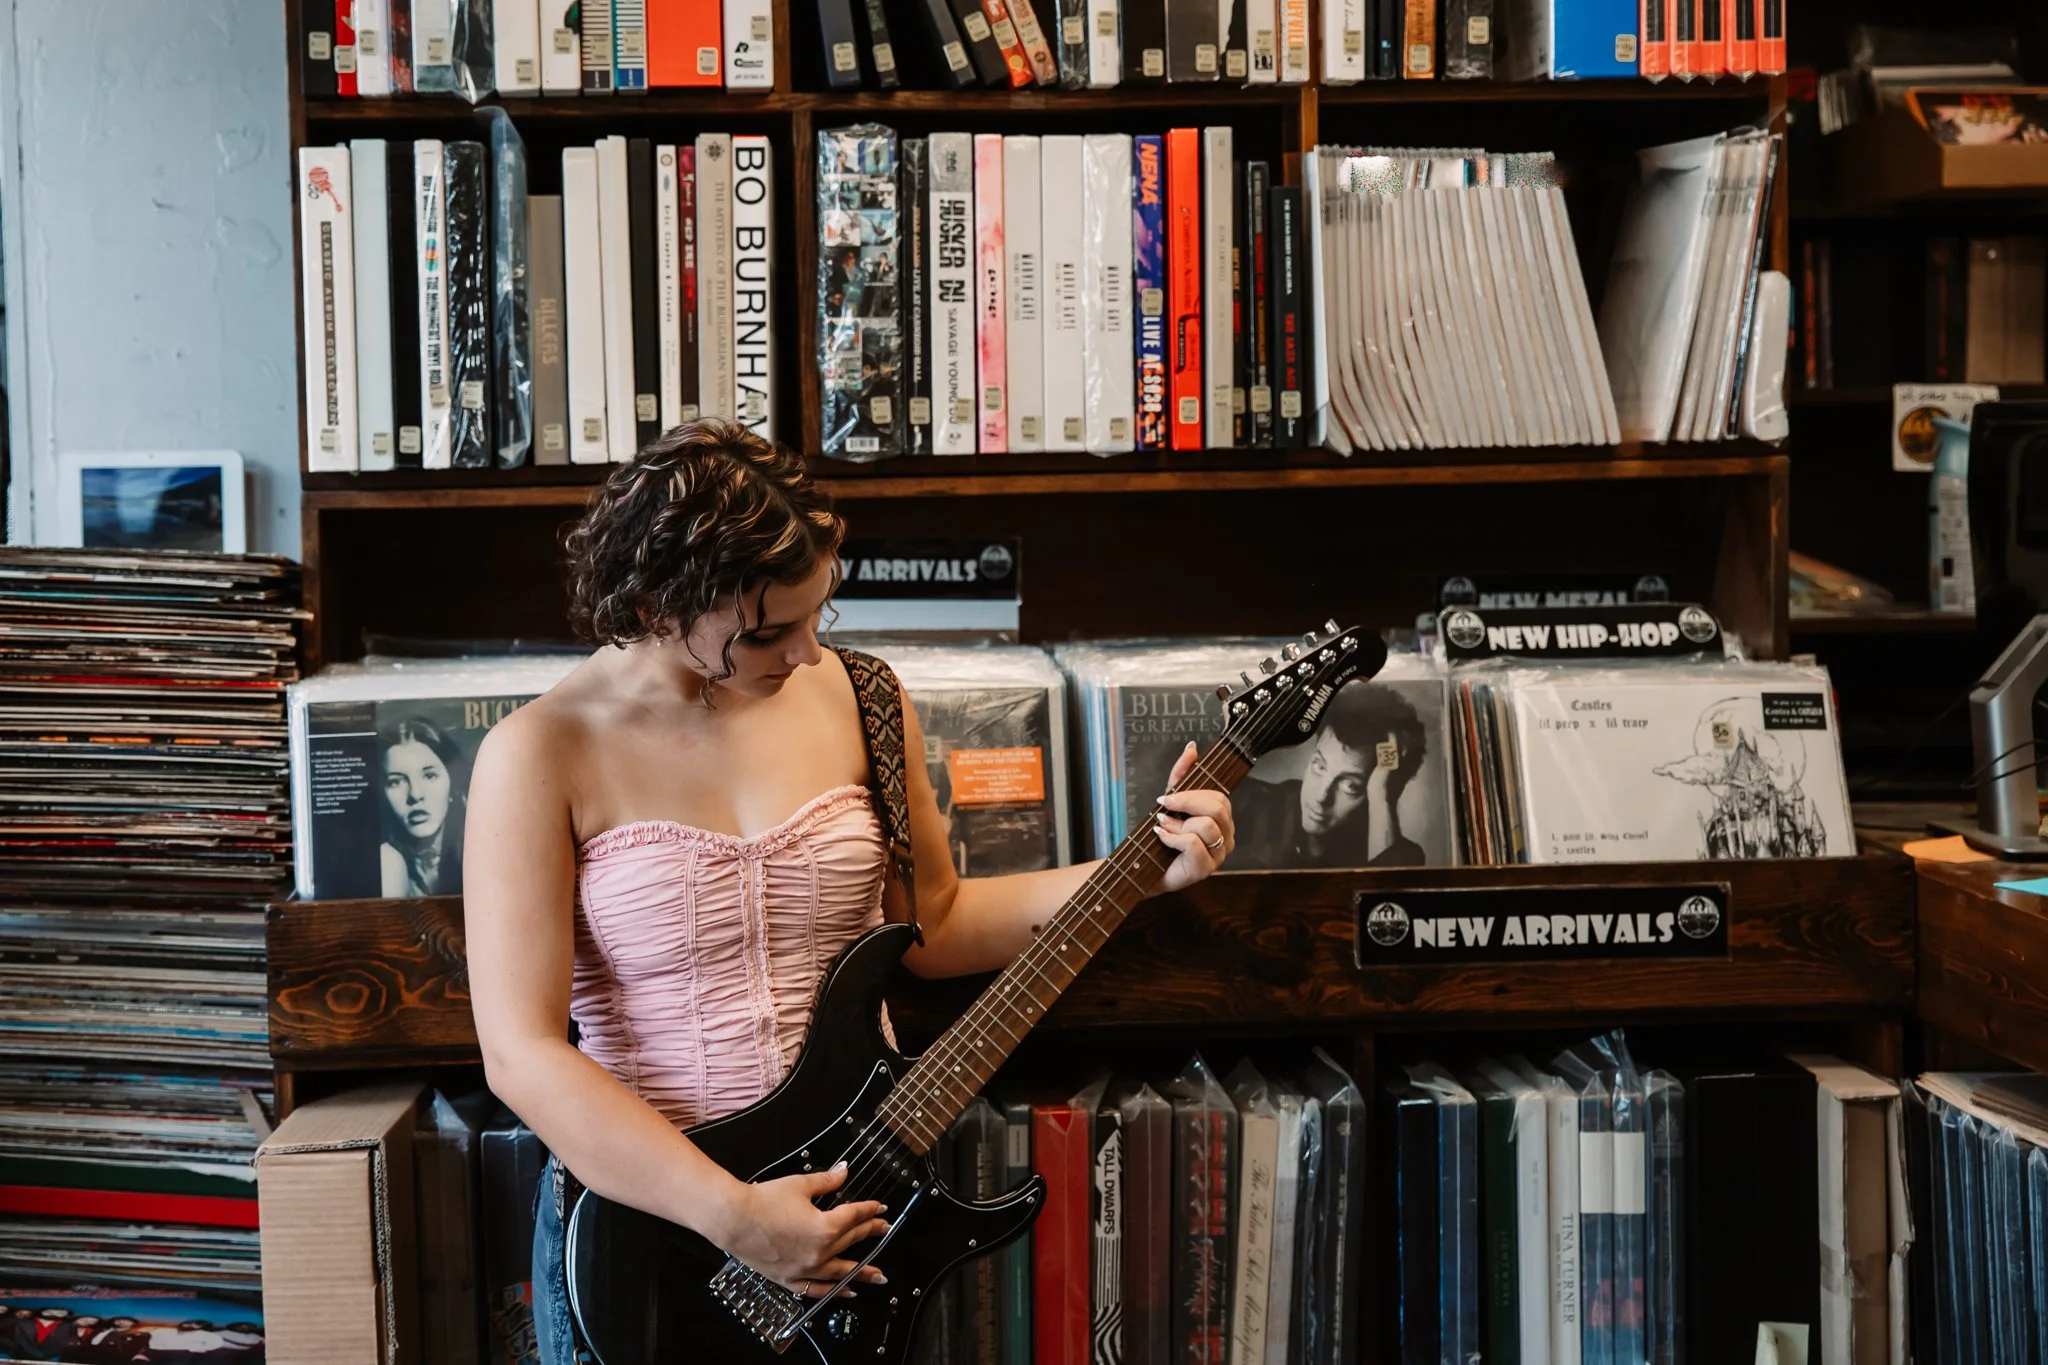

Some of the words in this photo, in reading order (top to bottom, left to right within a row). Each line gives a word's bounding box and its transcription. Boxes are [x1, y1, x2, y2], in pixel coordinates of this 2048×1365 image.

[735, 146, 766, 206] BO
[1140, 142, 1159, 206] NENA
[714, 182, 725, 204] THE
[714, 207, 726, 257] MYSTERY
[321, 223, 332, 281] CLASSIC
[715, 260, 727, 276] OF
[715, 280, 727, 302] THE
[913, 269, 922, 292] LIVE
[324, 287, 335, 332] ALBUM
[913, 293, 922, 306] AT
[540, 298, 558, 366] KILLERS
[716, 305, 728, 372] BULGARIAN
[946, 308, 958, 357] SAVAGE
[1142, 316, 1161, 349] LIVE
[1142, 353, 1162, 372] AT
[326, 338, 339, 420] COLLECTION
[857, 558, 978, 582] ARRIVALS
[1479, 592, 1540, 609] NEW
[1487, 625, 1551, 651] NEW
[1554, 621, 1681, 650] HIP-HOP
[1130, 691, 1213, 718] BILLY
[1303, 684, 1334, 722] YAMAHA
[1569, 699, 1613, 712] Castles
[1131, 717, 1222, 734] GREATES
[1606, 717, 1619, 729] lil
[1412, 916, 1495, 948] NEW
[1502, 912, 1675, 947] ARRIVALS
[1103, 1146, 1115, 1178] TALL
[1250, 1160, 1270, 1190] The
[1103, 1179, 1115, 1236] DWARFS
[1561, 1213, 1574, 1252] TINA
[1562, 1257, 1575, 1326] TURNER
